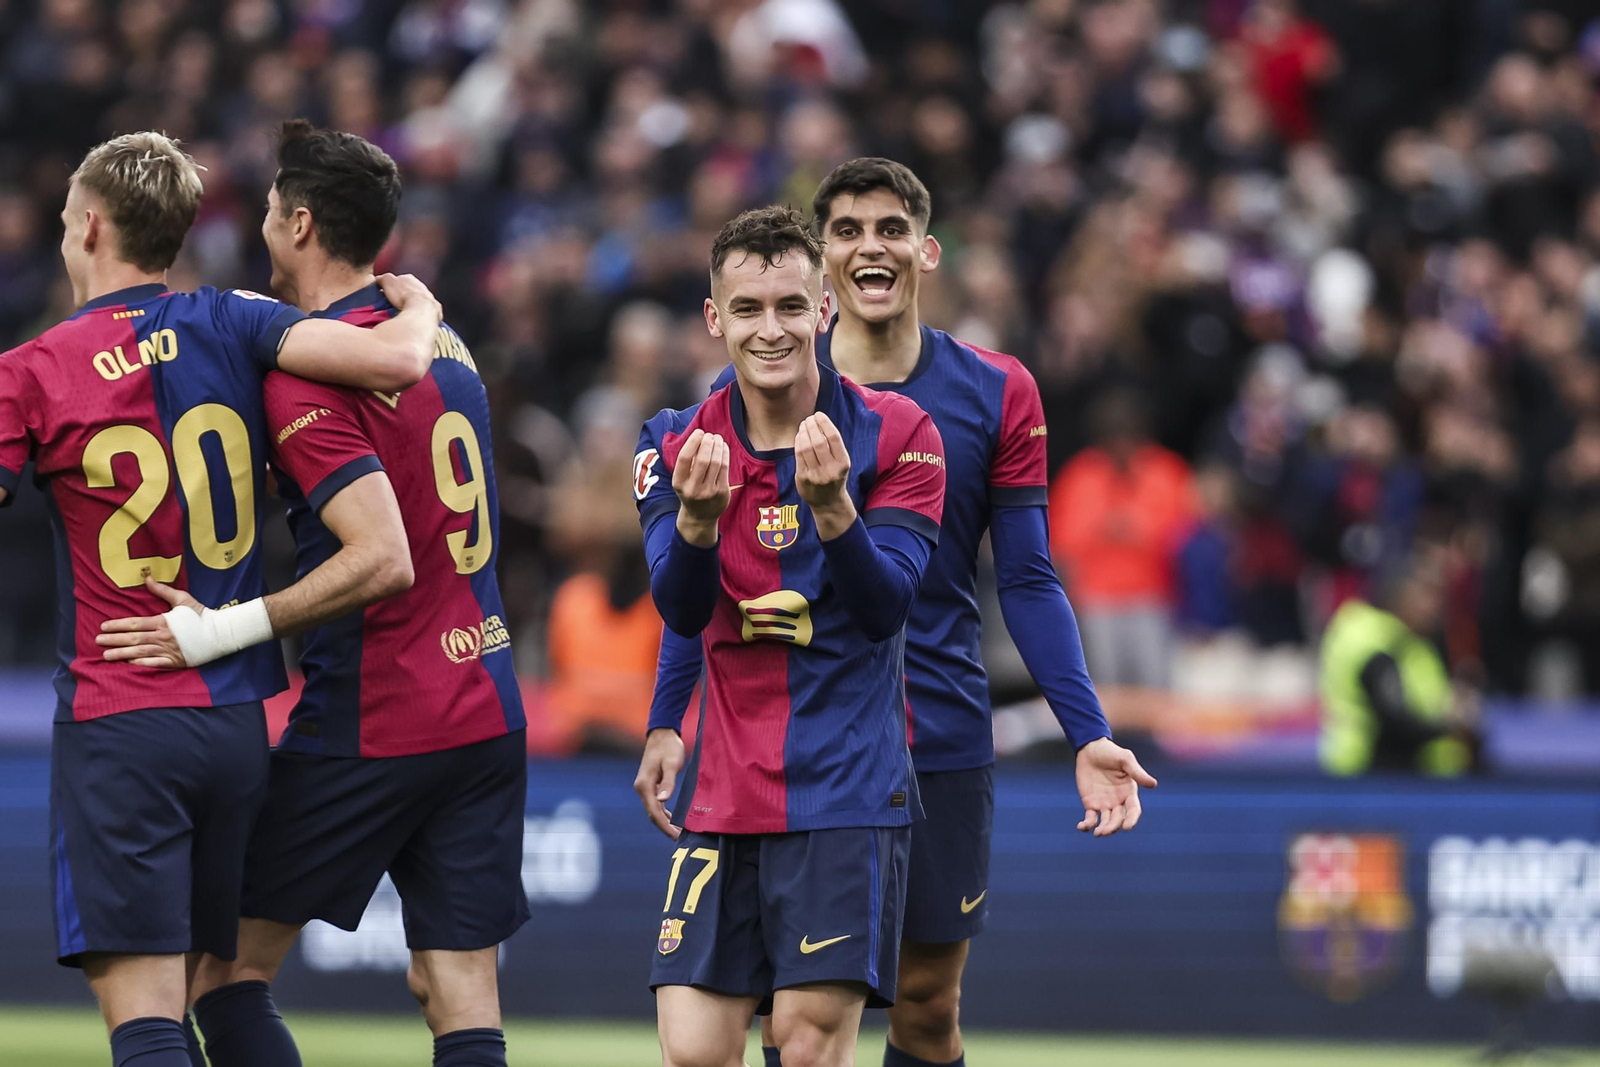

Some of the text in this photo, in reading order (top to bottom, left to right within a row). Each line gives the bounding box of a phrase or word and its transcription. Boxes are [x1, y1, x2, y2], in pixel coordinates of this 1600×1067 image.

[92, 328, 178, 381] OLMO
[82, 403, 255, 588] 20
[431, 410, 492, 575] 9
[663, 847, 719, 914] 17
